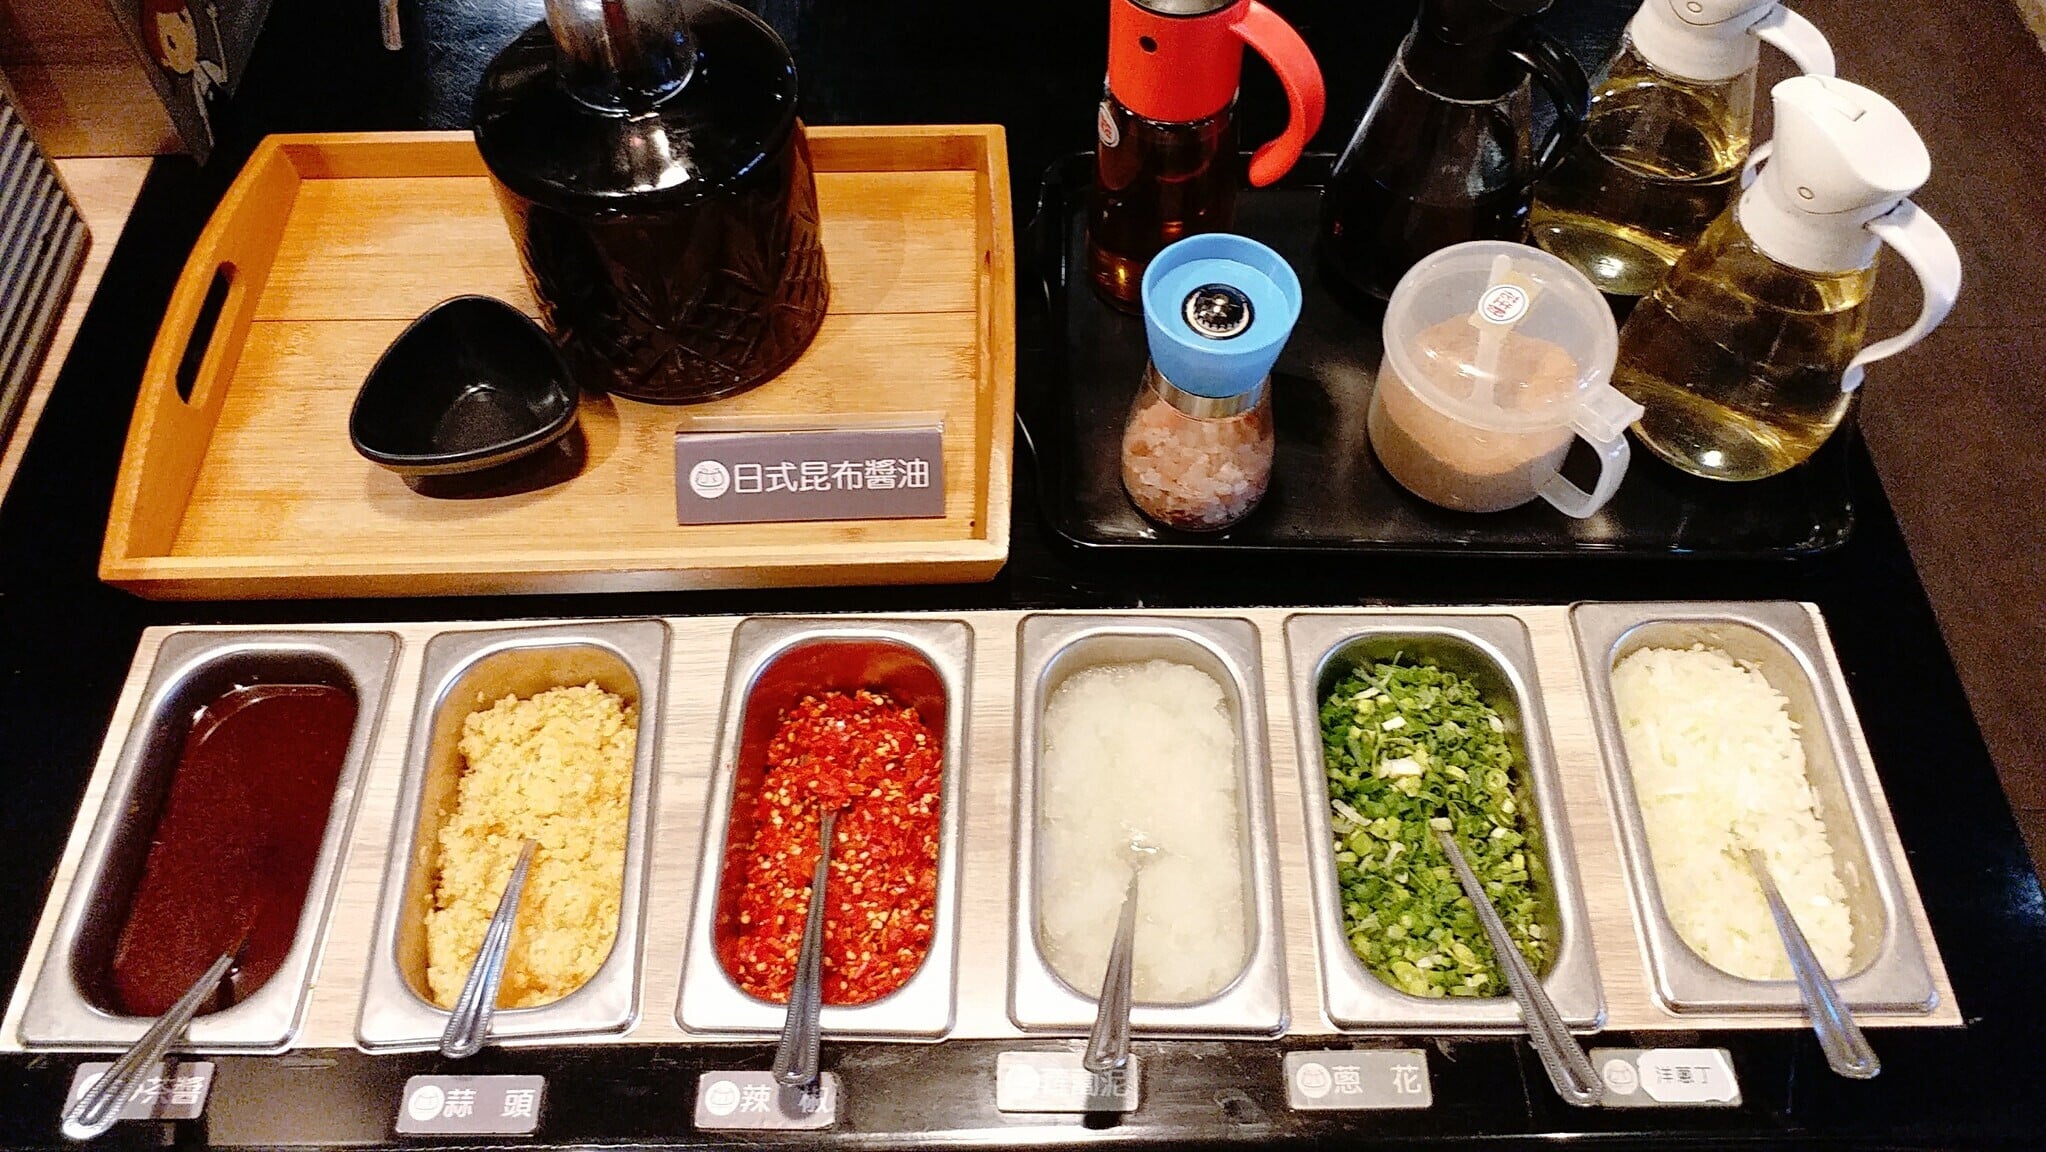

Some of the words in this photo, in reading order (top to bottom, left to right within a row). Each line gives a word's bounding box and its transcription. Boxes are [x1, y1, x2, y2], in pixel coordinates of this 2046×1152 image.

[733, 457, 930, 494] 日式昆布醬油
[122, 1076, 206, 1105] 茶醬
